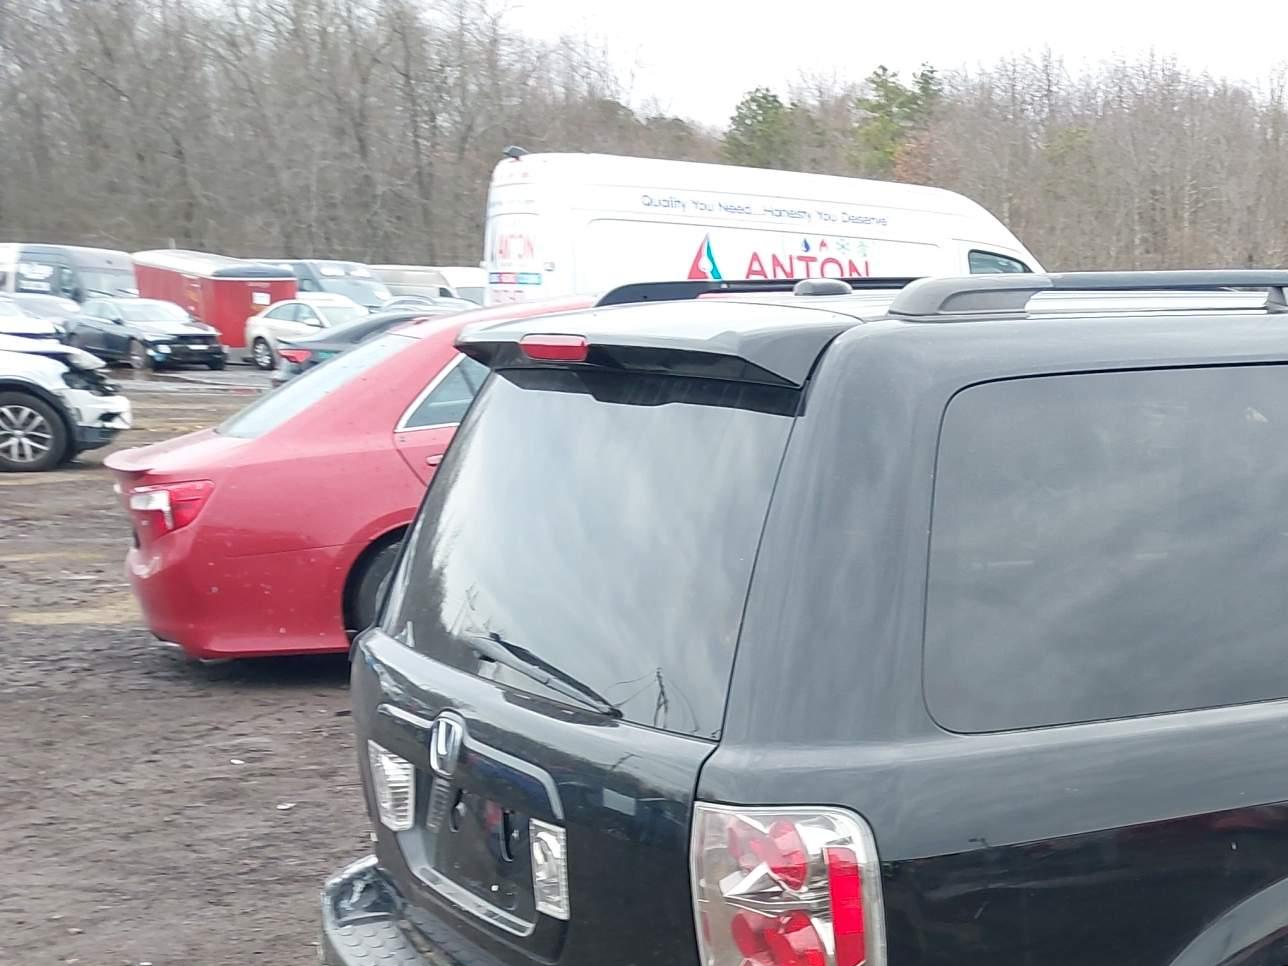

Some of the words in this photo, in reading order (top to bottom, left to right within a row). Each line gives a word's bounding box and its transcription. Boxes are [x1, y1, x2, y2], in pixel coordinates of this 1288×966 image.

[641, 194, 687, 212] Quality
[692, 199, 714, 212] You
[816, 211, 837, 223] You
[841, 212, 888, 227] Deserve
[745, 251, 870, 280] ANTON
